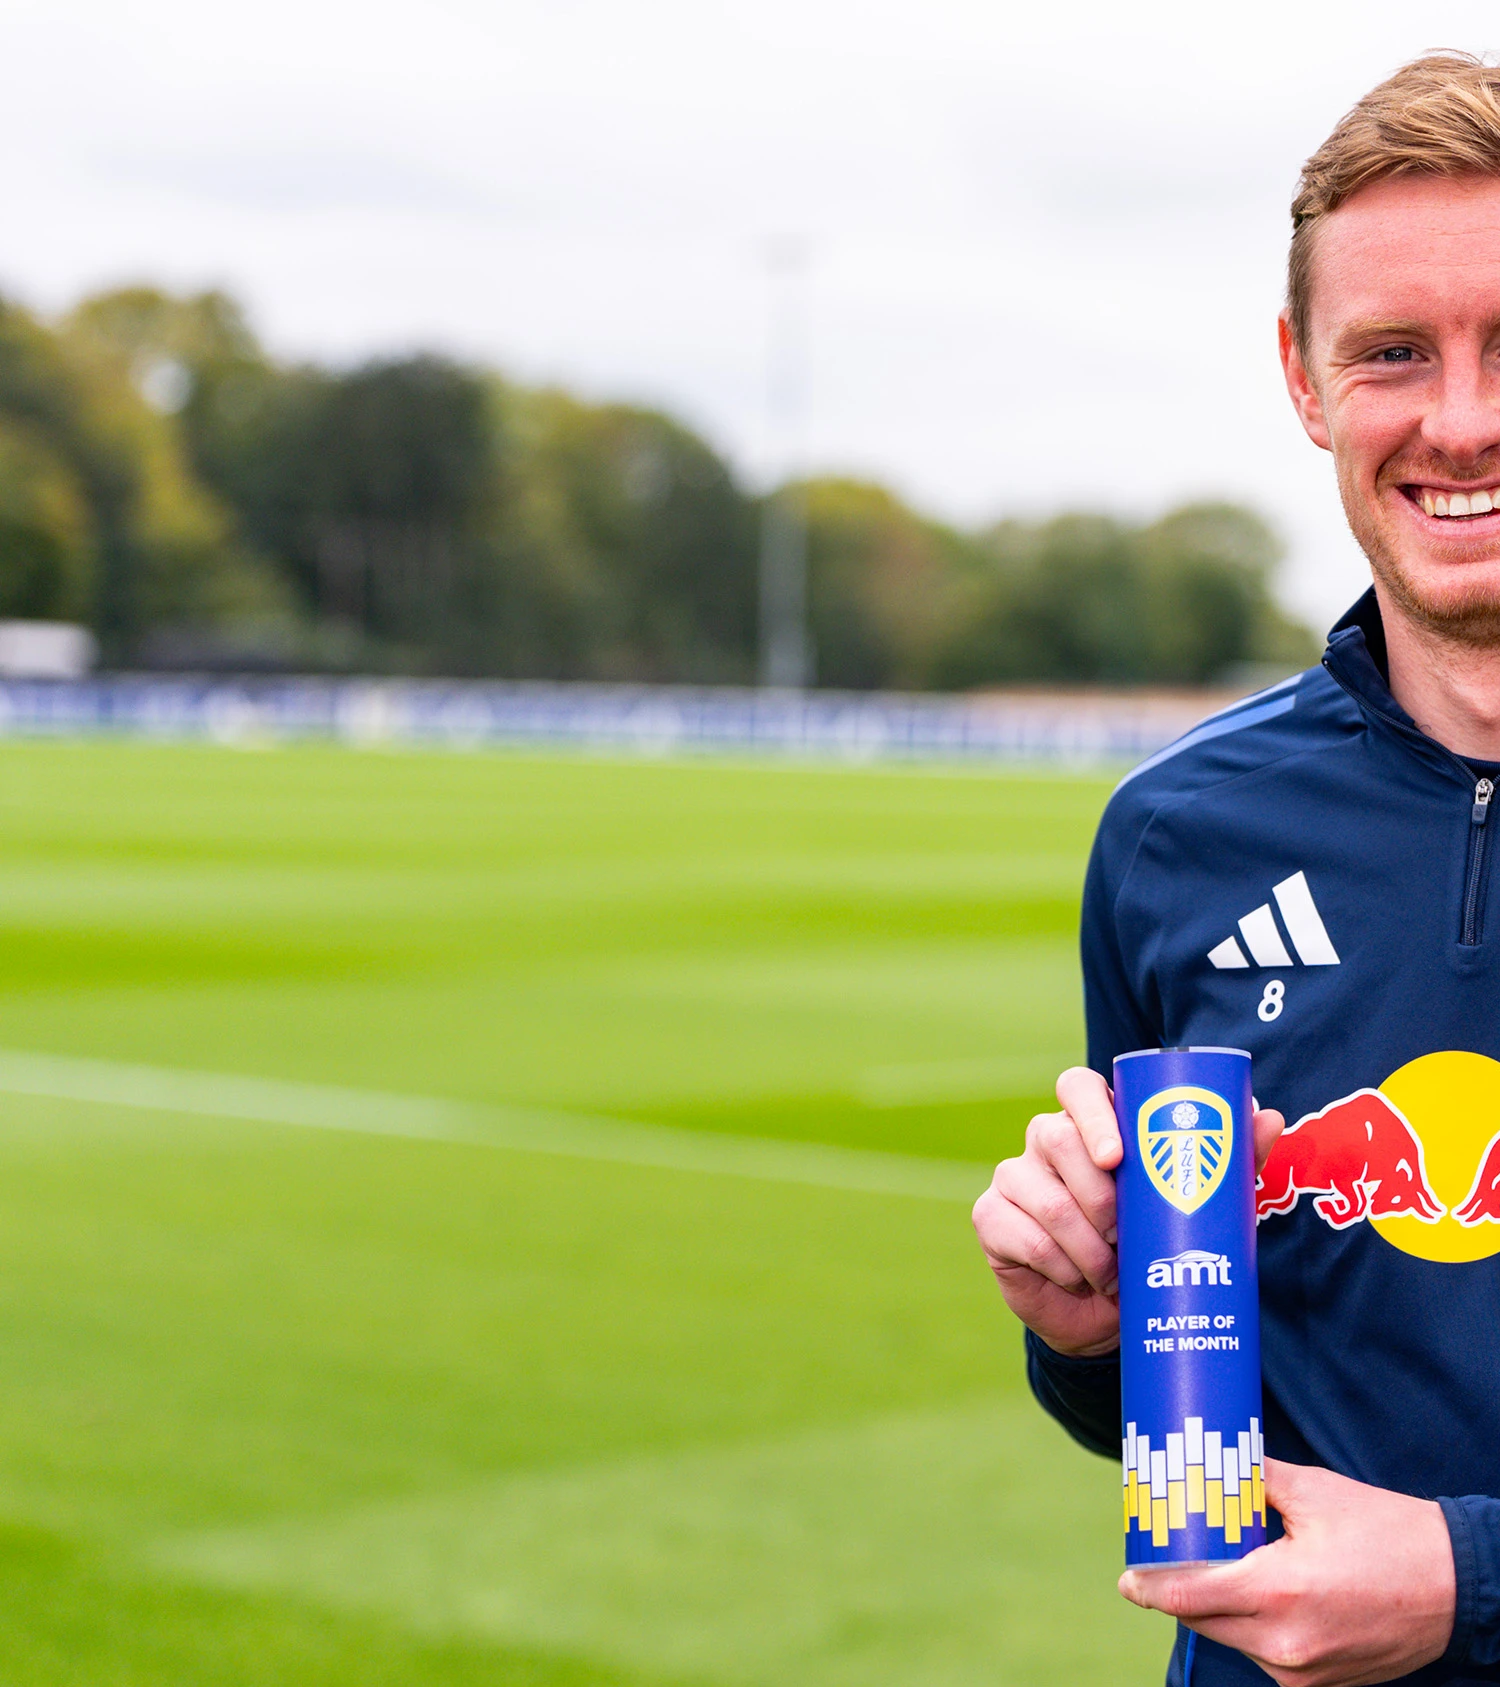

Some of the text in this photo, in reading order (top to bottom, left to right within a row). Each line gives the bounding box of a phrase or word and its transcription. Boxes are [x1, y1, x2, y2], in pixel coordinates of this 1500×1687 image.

[1257, 979, 1285, 1022] 8
[1179, 1136, 1194, 1197] LUFC
[1146, 1253, 1233, 1288] amt
[1147, 1315, 1236, 1332] PLAYER OF
[1143, 1336, 1240, 1353] THE MONTH
